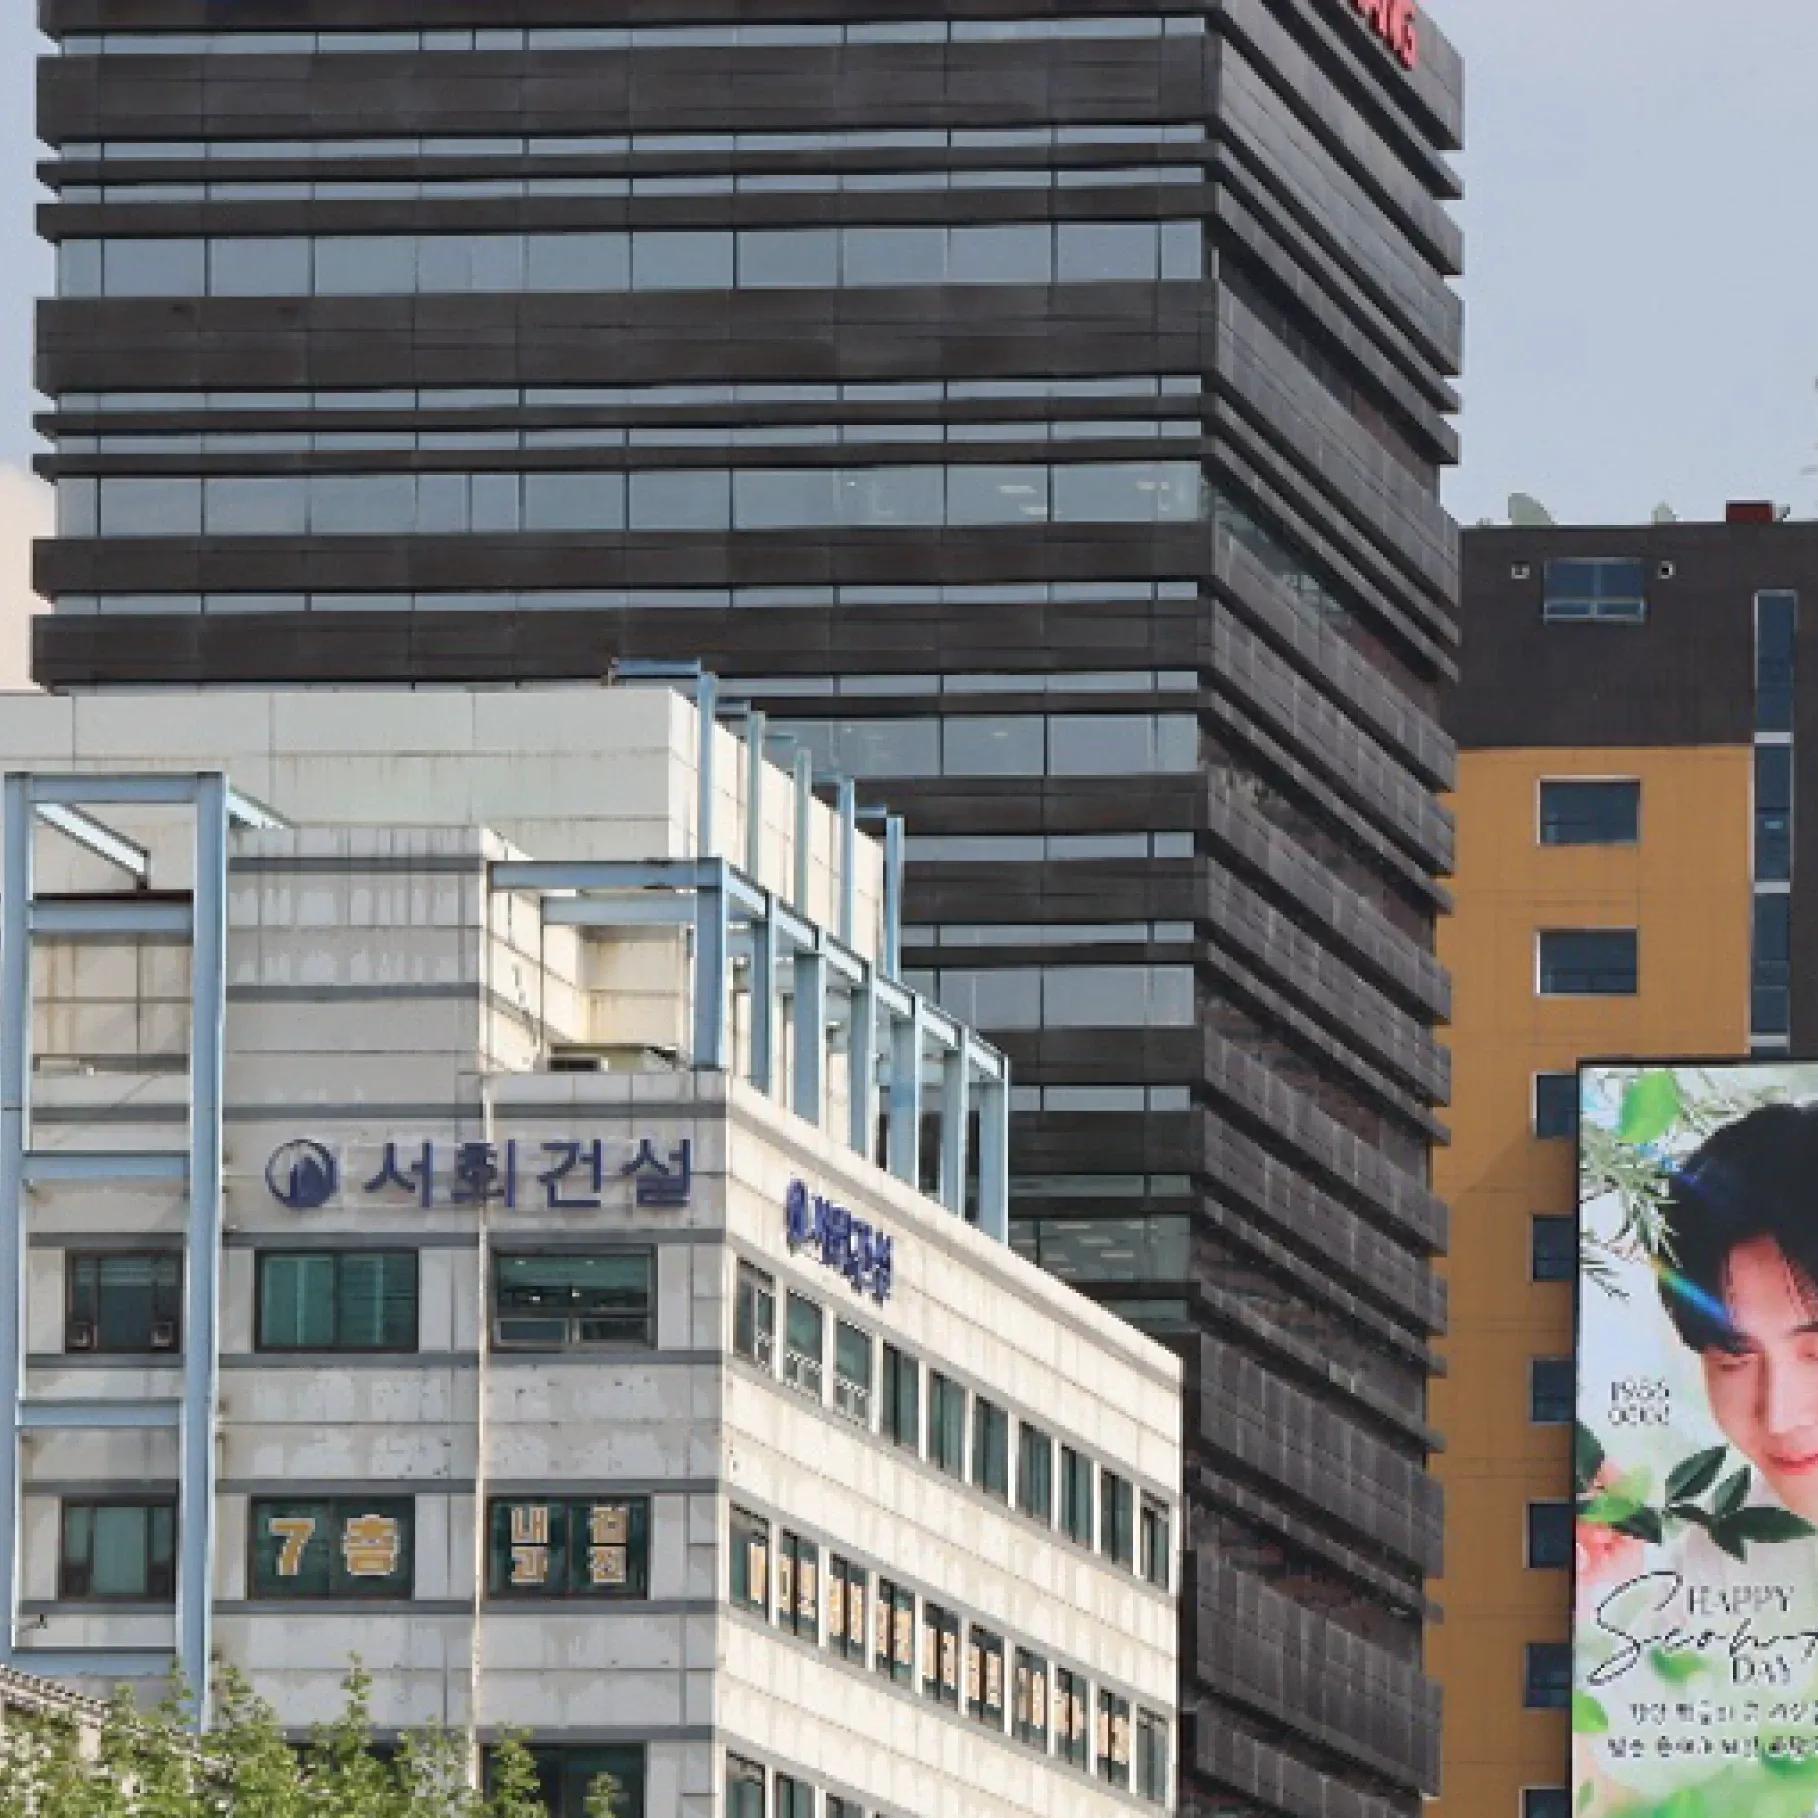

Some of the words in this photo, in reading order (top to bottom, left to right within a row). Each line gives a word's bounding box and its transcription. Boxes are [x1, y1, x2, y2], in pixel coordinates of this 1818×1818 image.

[361, 1138, 691, 1209] 서희건설
[267, 1513, 399, 1577] 7층
[1687, 1584, 1795, 1615] HAPPY
[1731, 1652, 1793, 1685] DAY
